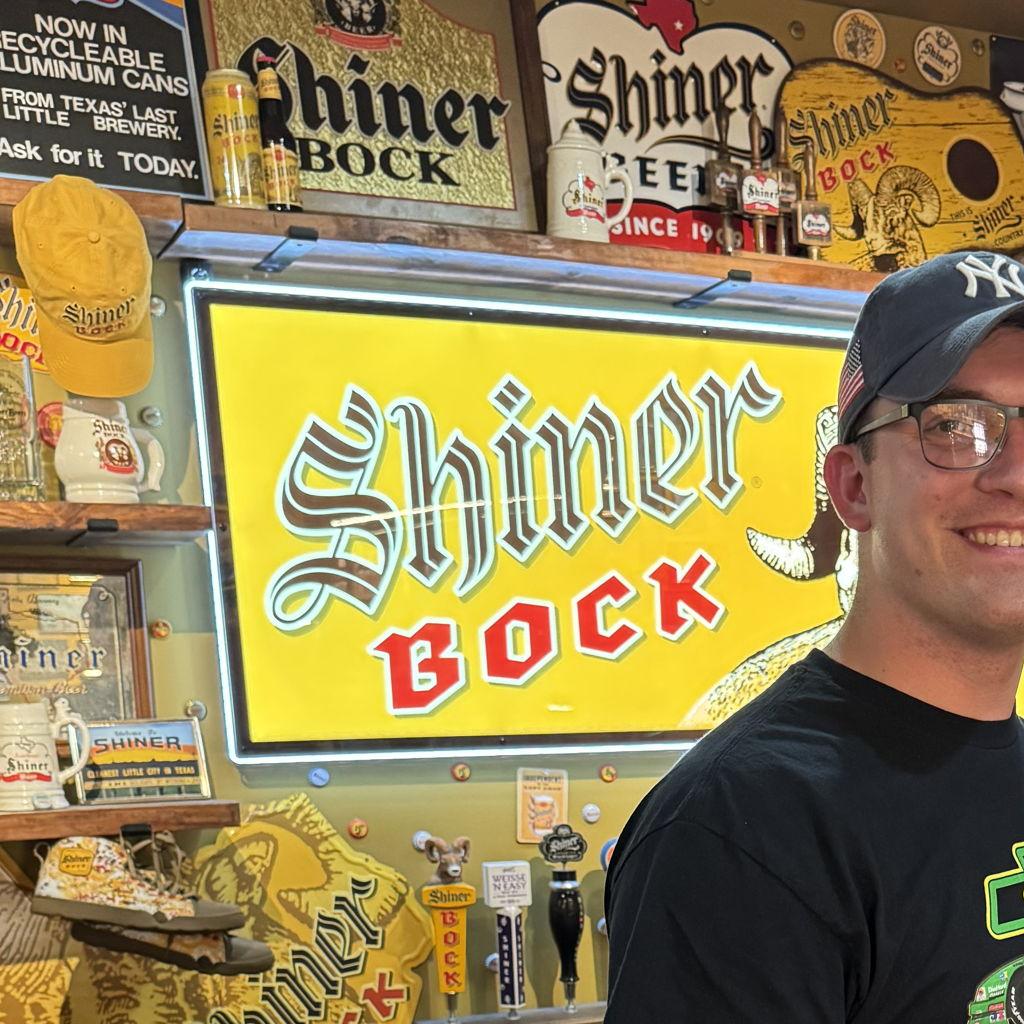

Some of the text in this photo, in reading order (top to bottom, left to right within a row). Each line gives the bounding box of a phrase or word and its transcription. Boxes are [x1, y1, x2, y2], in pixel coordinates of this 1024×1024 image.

[34, 13, 128, 45] NOW IN
[0, 30, 167, 73] ECYCLEABLE
[0, 52, 190, 97] LUMINUM CANS
[1, 87, 178, 124] FROM TEXAS' LAST
[566, 46, 774, 146] Shiner
[3, 104, 183, 141] LITTLE BREWERY.
[788, 88, 897, 172] Shiner
[0, 136, 200, 179] Ask for it TODAY.
[297, 137, 461, 187] BOCK
[602, 152, 708, 196] BEE
[817, 142, 896, 192] BOCK
[747, 184, 778, 201] Shiner
[611, 216, 679, 240] SINCE
[973, 196, 1016, 240] Shiner
[62, 296, 137, 328] Shiner
[74, 322, 128, 335] BOCK
[264, 361, 783, 631] Shiner
[367, 549, 728, 716] BOCK
[93, 735, 182, 754] SHINER
[6, 757, 49, 774] Shiner
[62, 854, 92, 864] Shiner
[428, 889, 472, 905] Shiner
[503, 882, 527, 891] EASY
[441, 909, 462, 988] BOCK
